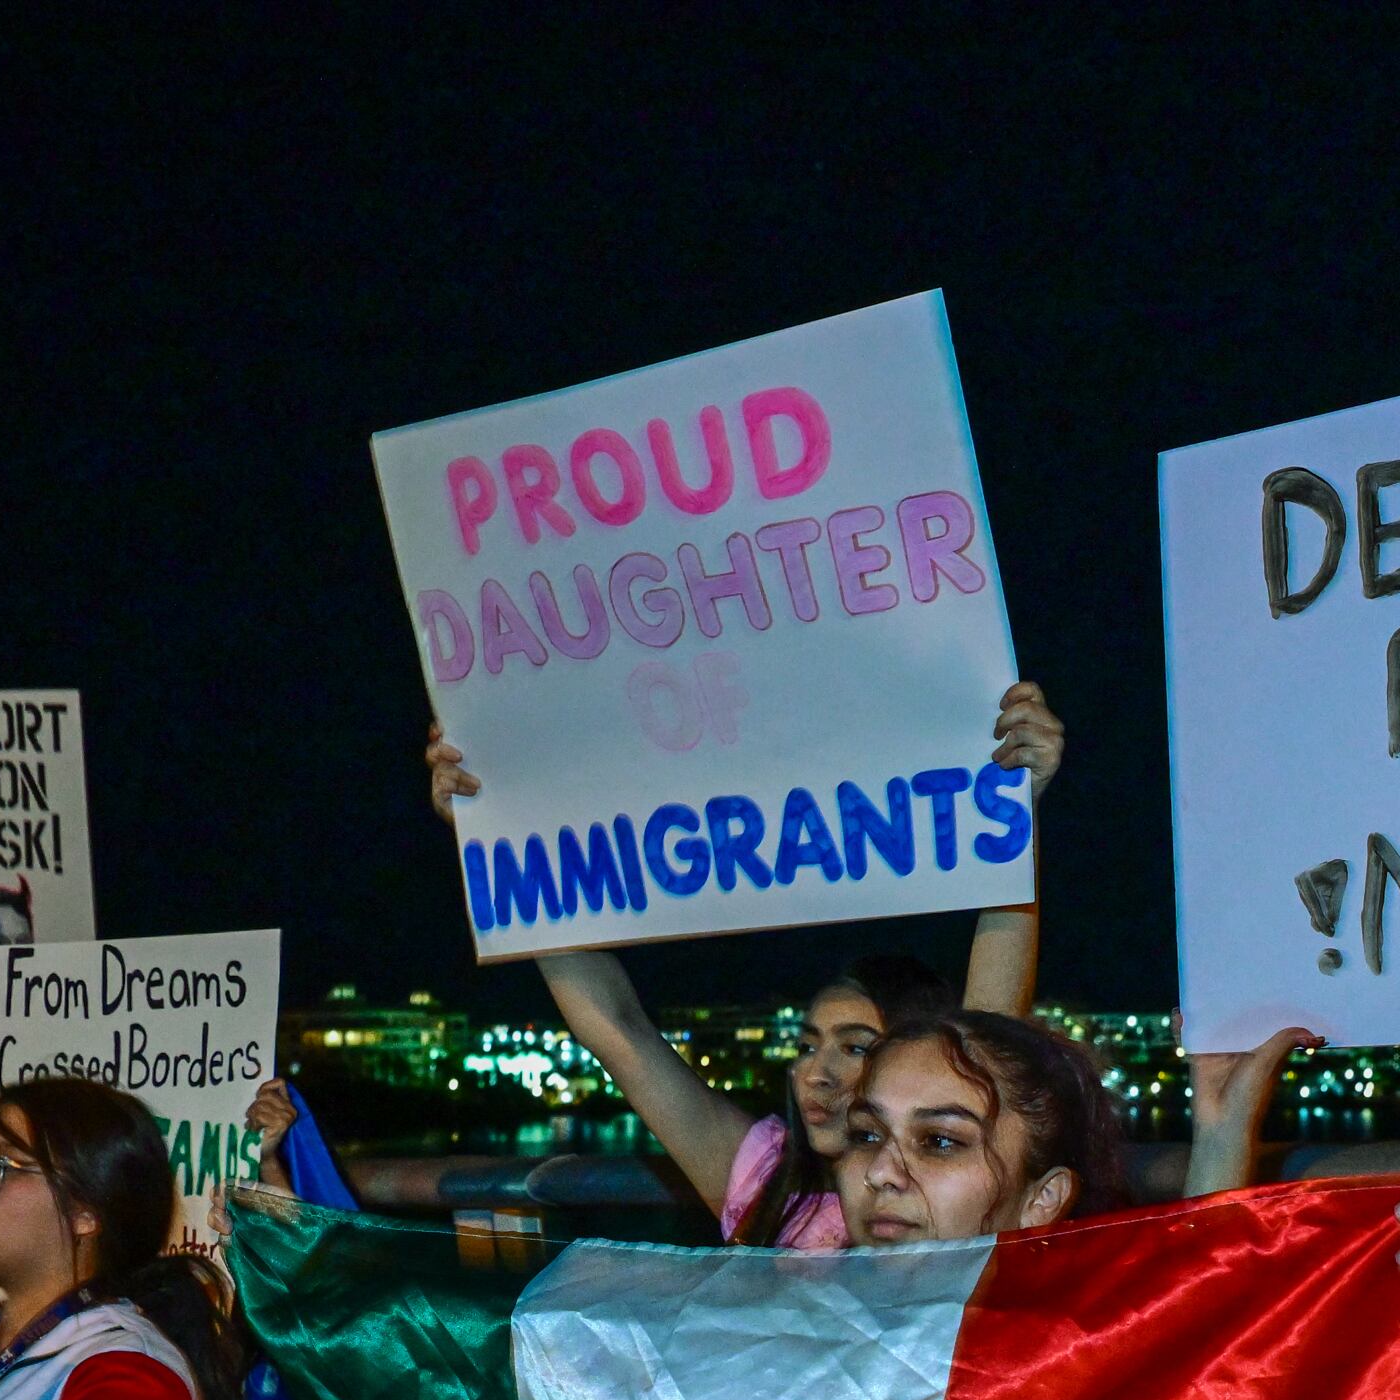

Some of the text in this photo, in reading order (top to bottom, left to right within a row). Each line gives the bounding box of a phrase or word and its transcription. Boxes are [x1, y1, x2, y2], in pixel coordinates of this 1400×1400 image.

[446, 386, 832, 555] PROUD
[415, 490, 985, 682] DAUGHTER
[627, 651, 750, 752] OF
[464, 761, 1032, 931] IMMIGRANTS
[5, 948, 89, 1019] From
[102, 944, 246, 1015] Dreams
[129, 1022, 262, 1089] Borders
